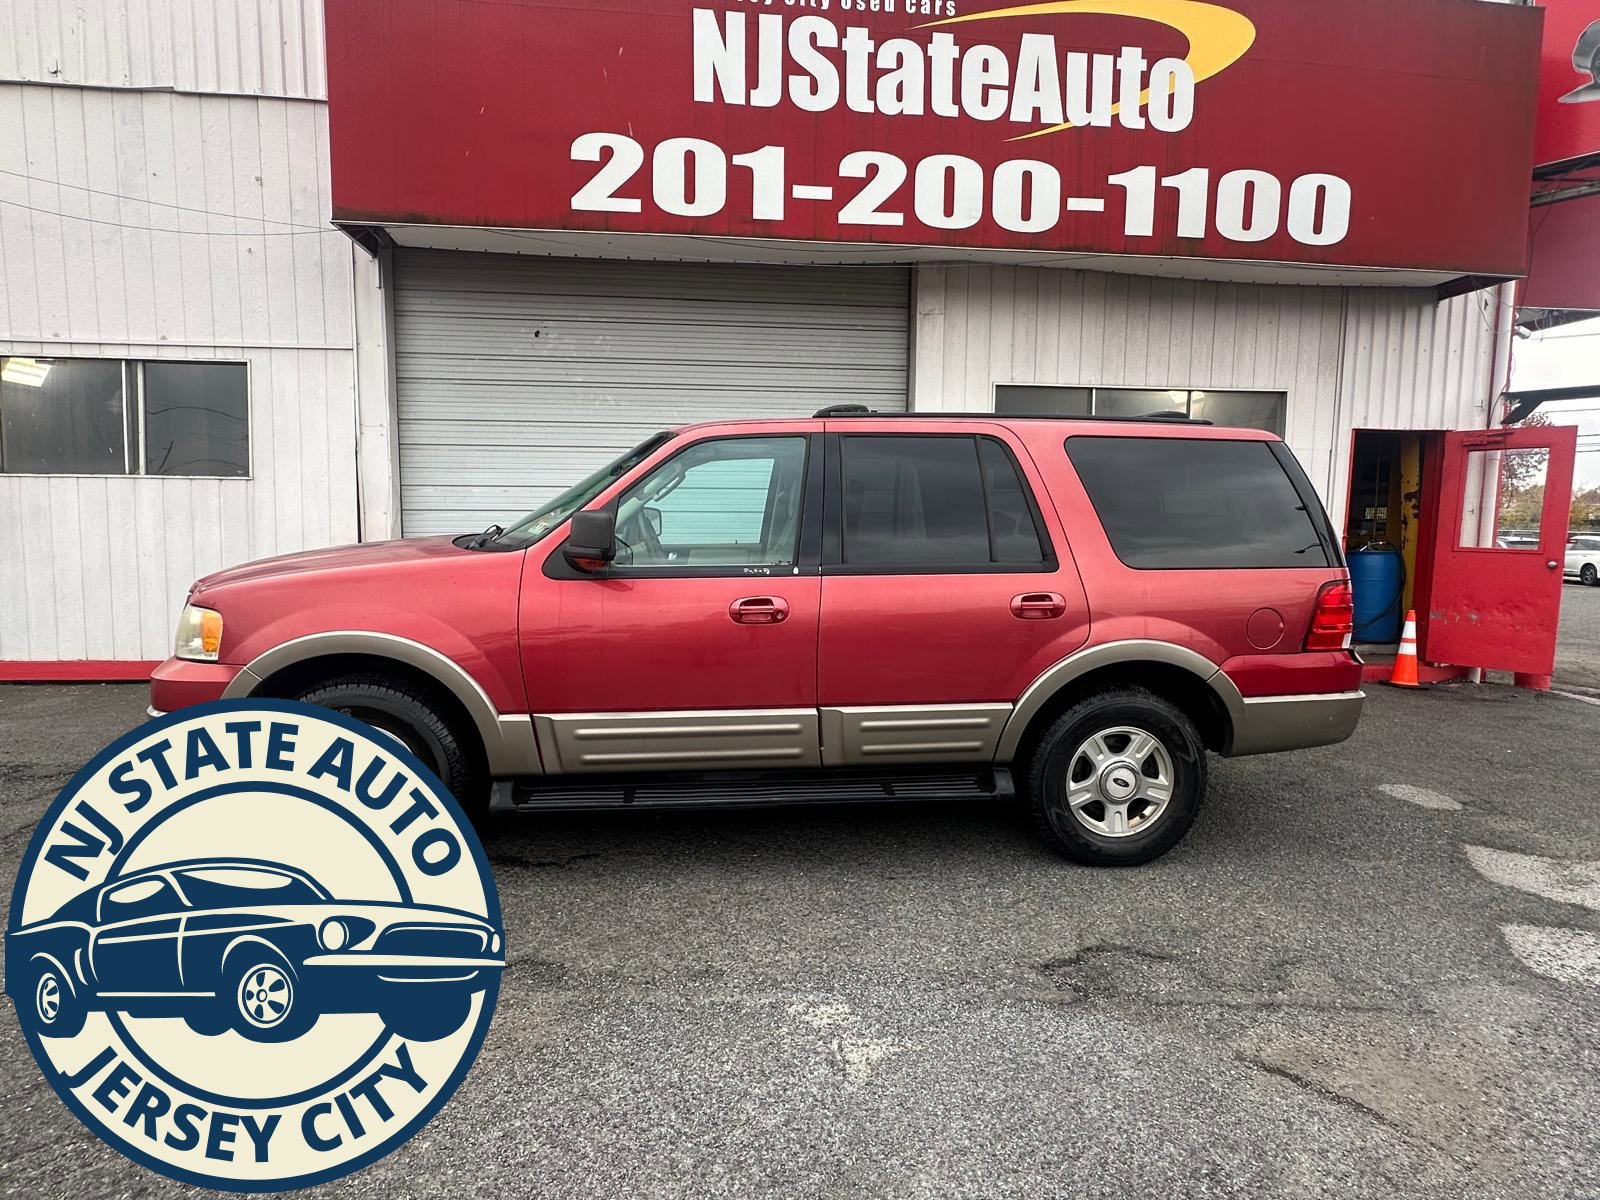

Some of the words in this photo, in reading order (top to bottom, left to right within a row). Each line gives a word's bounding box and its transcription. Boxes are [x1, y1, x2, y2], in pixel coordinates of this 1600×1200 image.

[905, 0, 956, 16] Cars
[692, 8, 1196, 132] NJStateAuto
[570, 133, 1352, 245] 201-200-1100
